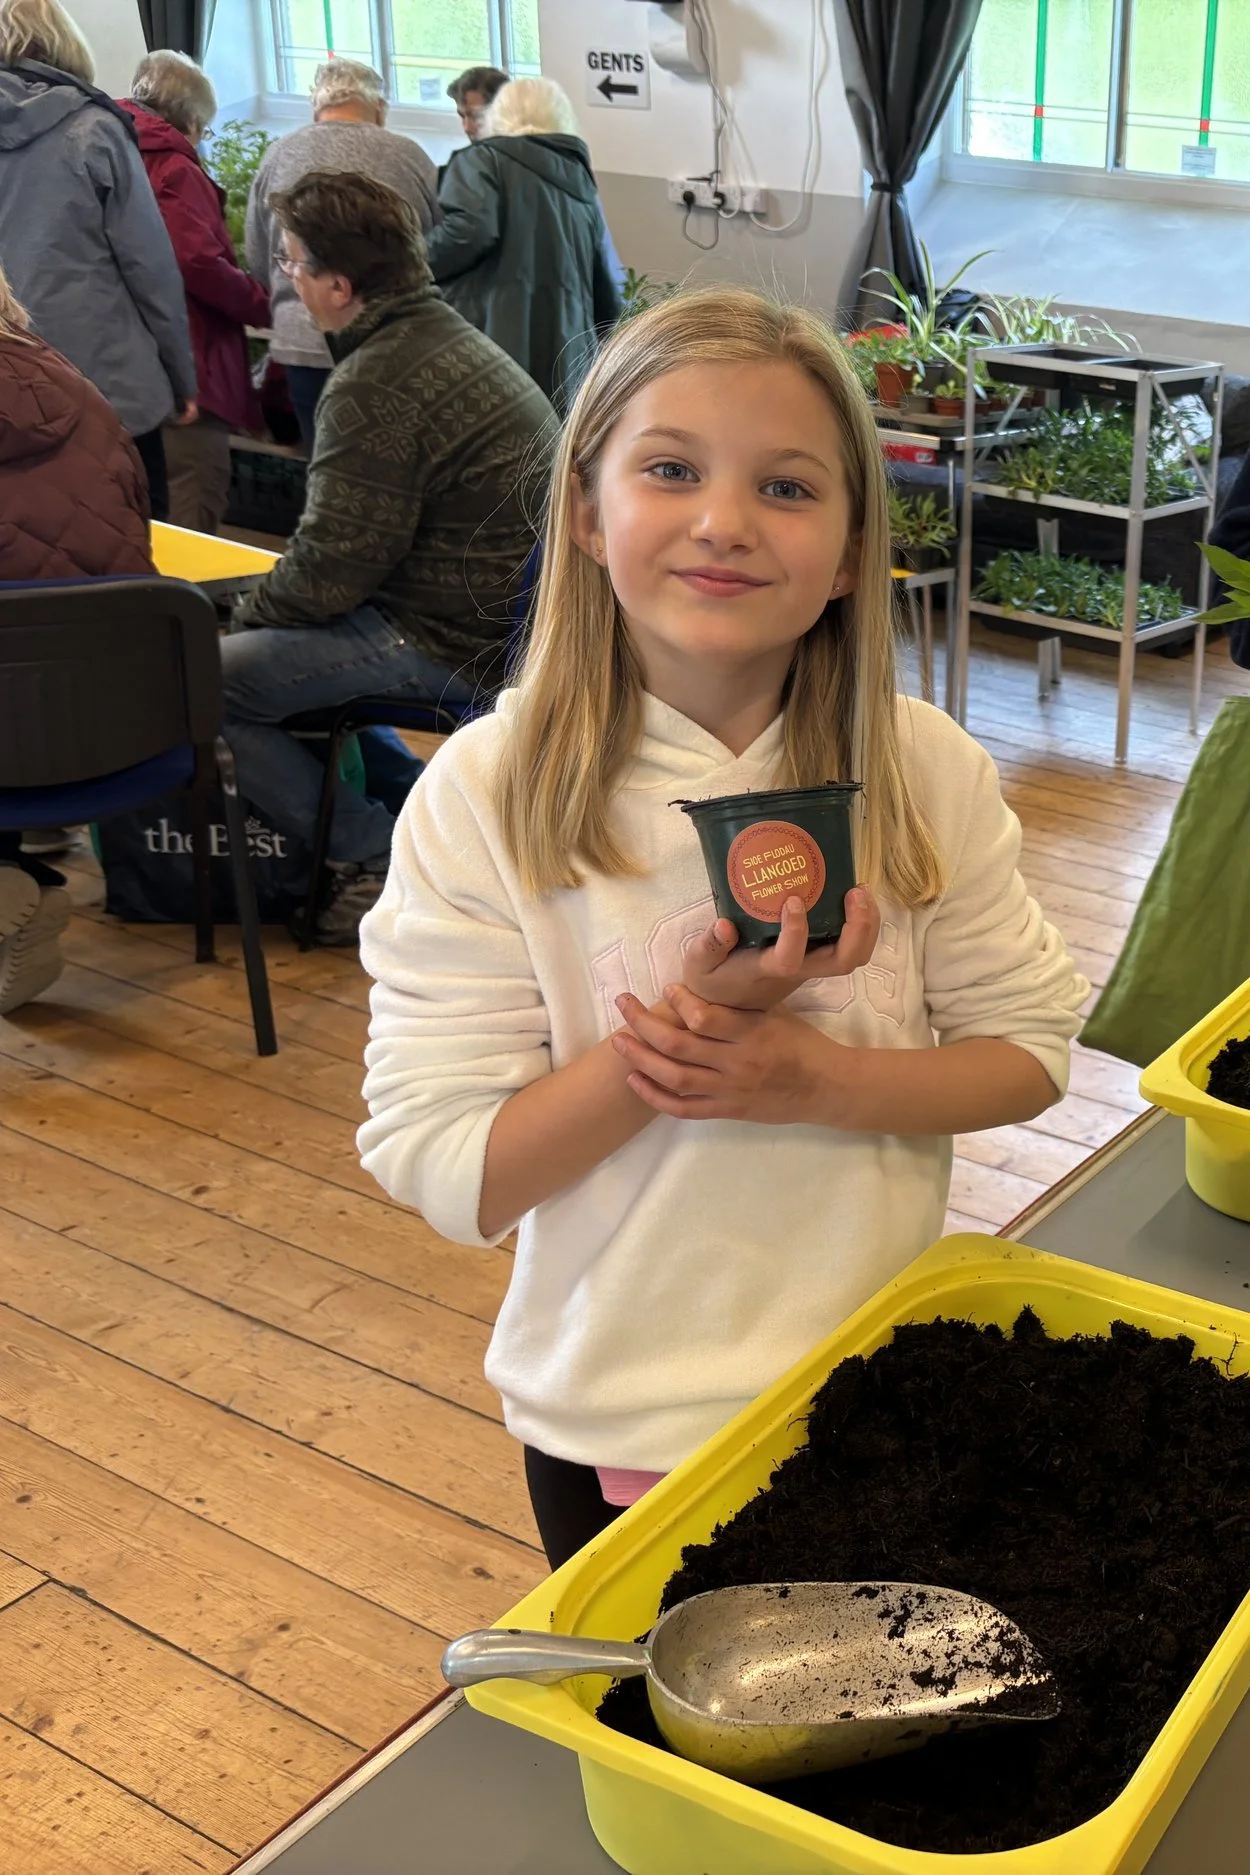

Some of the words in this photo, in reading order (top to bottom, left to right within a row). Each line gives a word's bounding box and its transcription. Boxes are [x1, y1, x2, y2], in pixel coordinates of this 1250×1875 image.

[587, 52, 644, 72] GENTS
[743, 855, 762, 868] SIOE
[764, 844, 795, 861] FLODAU
[742, 856, 806, 888] LLANGOED
[752, 884, 782, 900] FLOWER
[784, 874, 808, 890] SHOW
